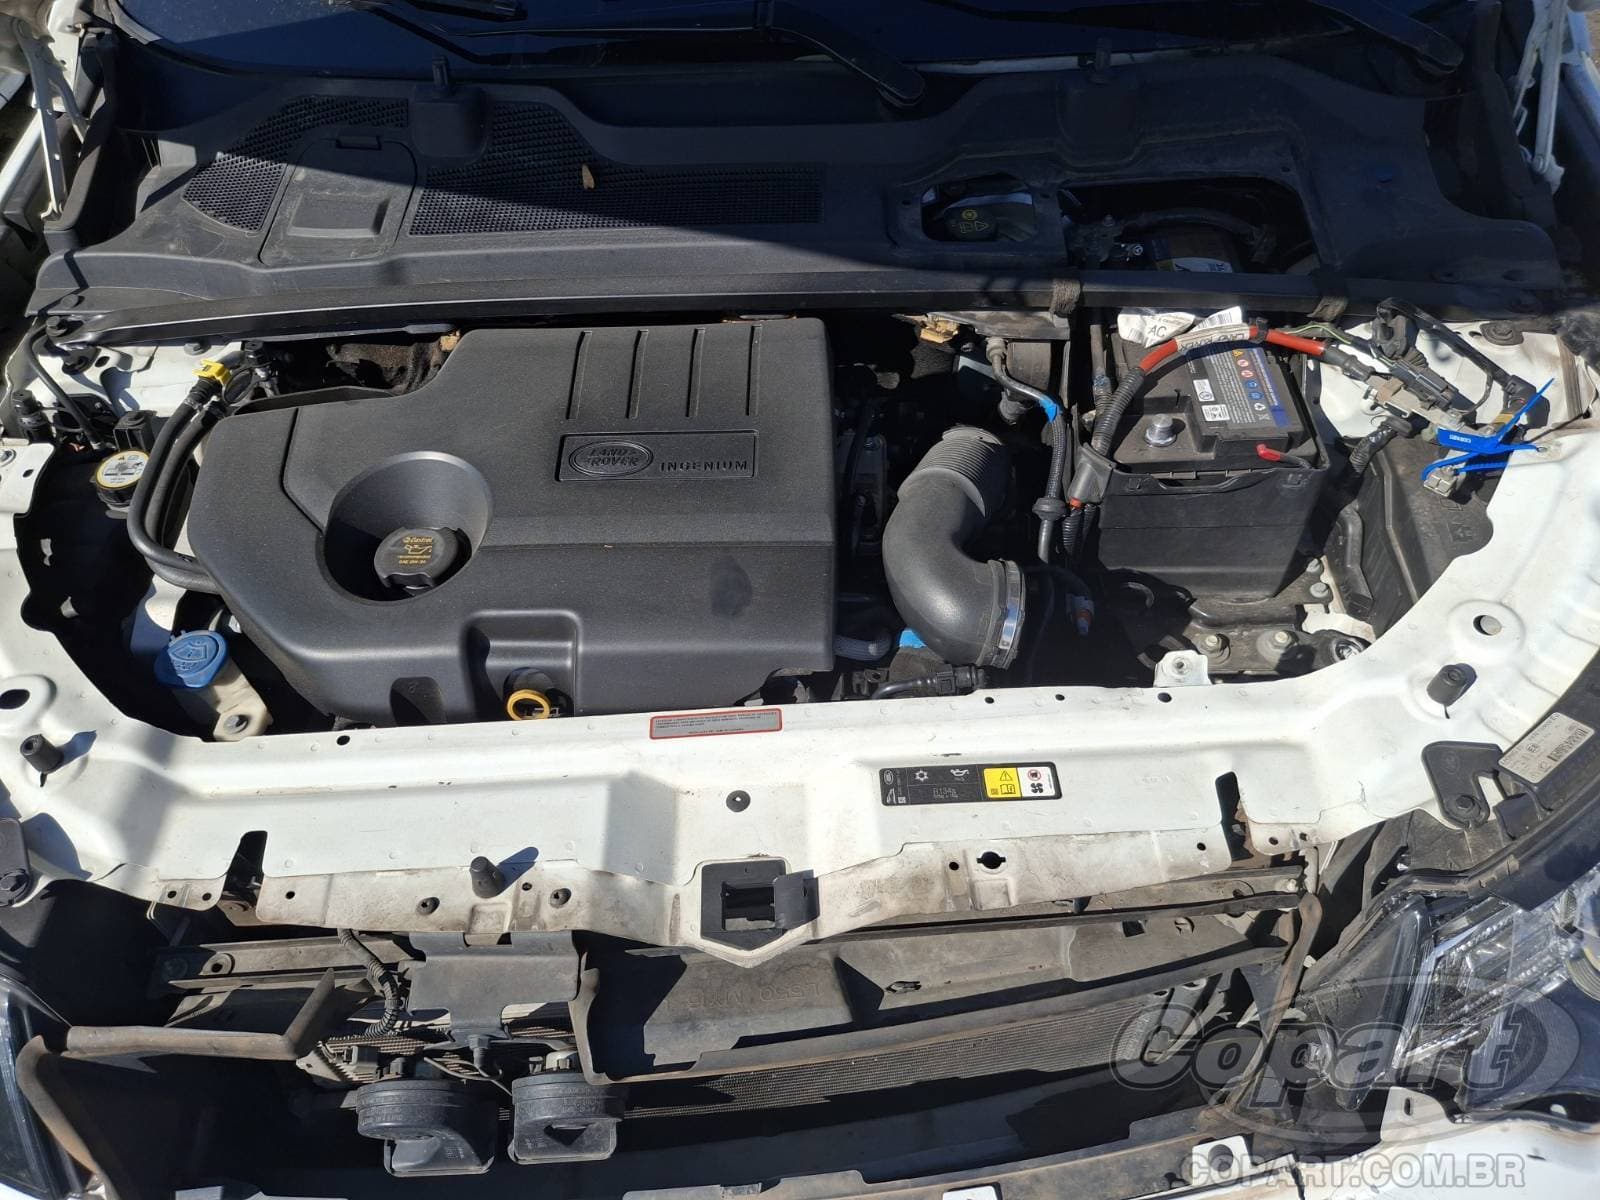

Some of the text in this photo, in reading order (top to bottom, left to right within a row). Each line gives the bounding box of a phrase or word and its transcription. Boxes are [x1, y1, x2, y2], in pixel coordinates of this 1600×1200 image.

[588, 448, 630, 457] LAND
[589, 456, 640, 467] ROVER
[660, 460, 748, 472] INGENIUM
